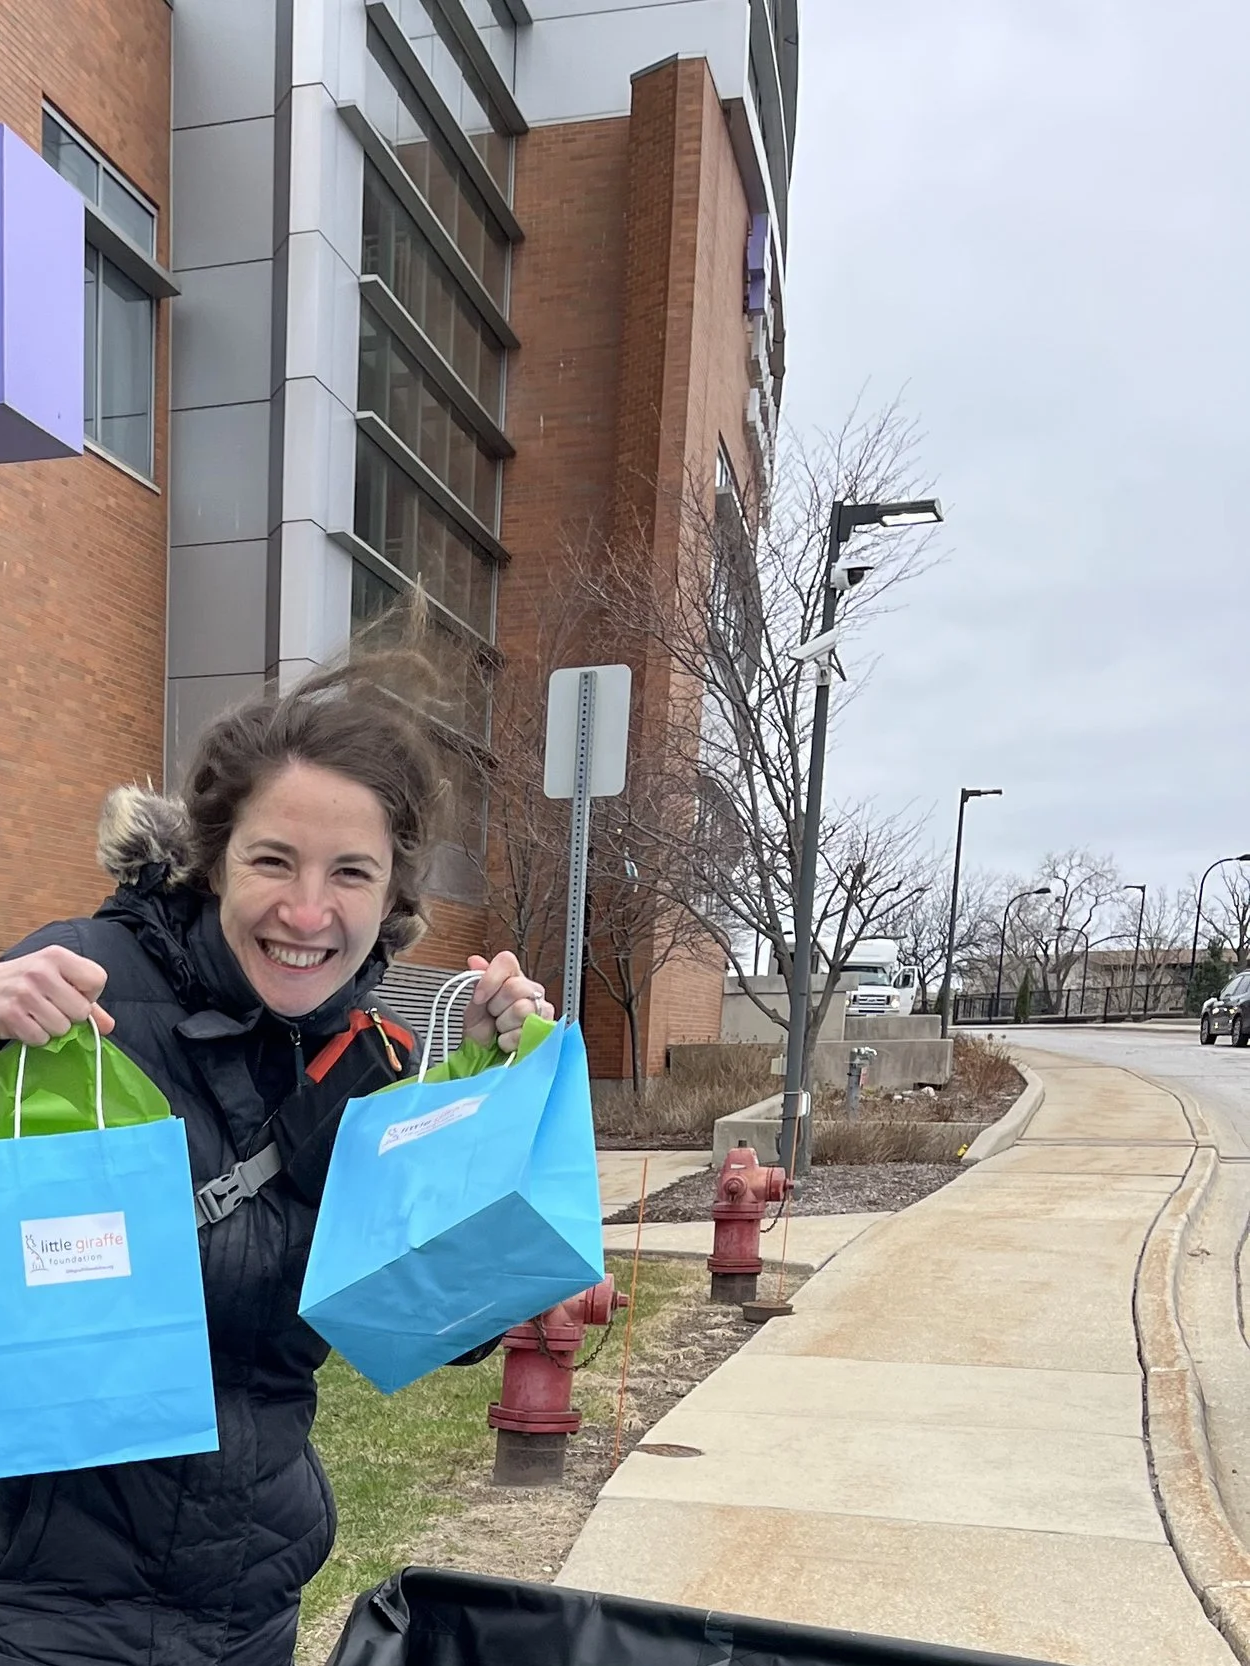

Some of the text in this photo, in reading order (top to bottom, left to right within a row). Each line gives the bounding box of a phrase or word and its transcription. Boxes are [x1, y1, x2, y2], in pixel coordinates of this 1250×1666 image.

[41, 1232, 124, 1254] little giraffe
[49, 1254, 103, 1265] foundation
